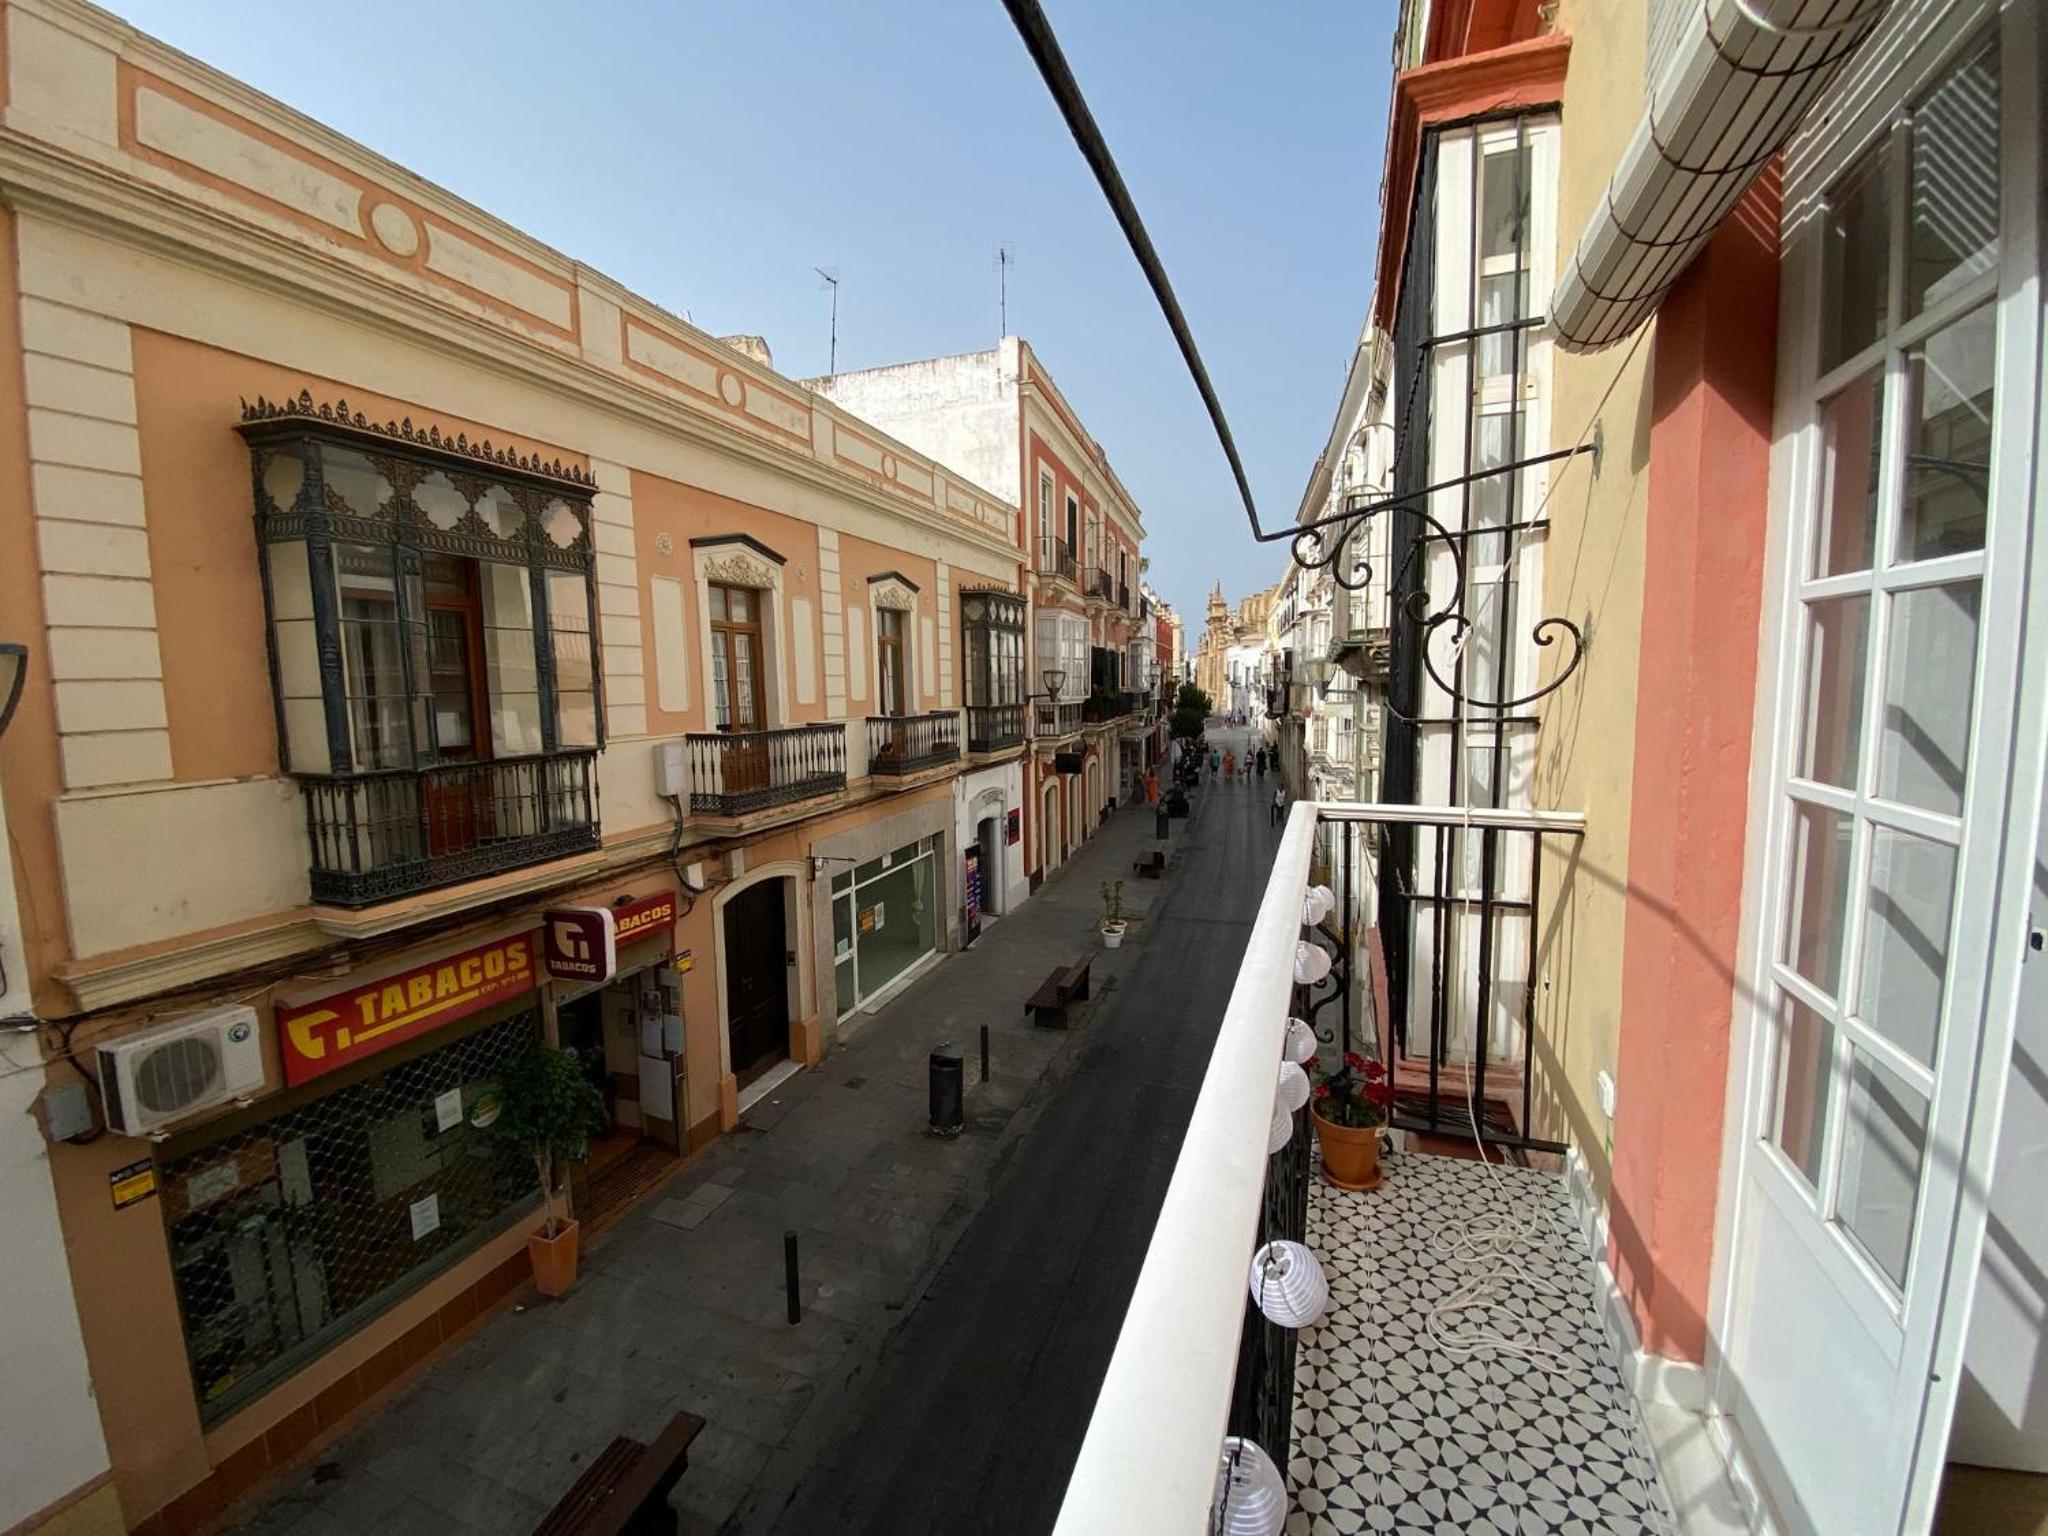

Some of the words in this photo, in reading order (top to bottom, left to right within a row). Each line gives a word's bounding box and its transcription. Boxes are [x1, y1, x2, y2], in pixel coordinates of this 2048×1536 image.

[615, 904, 671, 933] BACOS
[550, 960, 597, 974] TABACOS
[356, 942, 526, 1025] TABACOS
